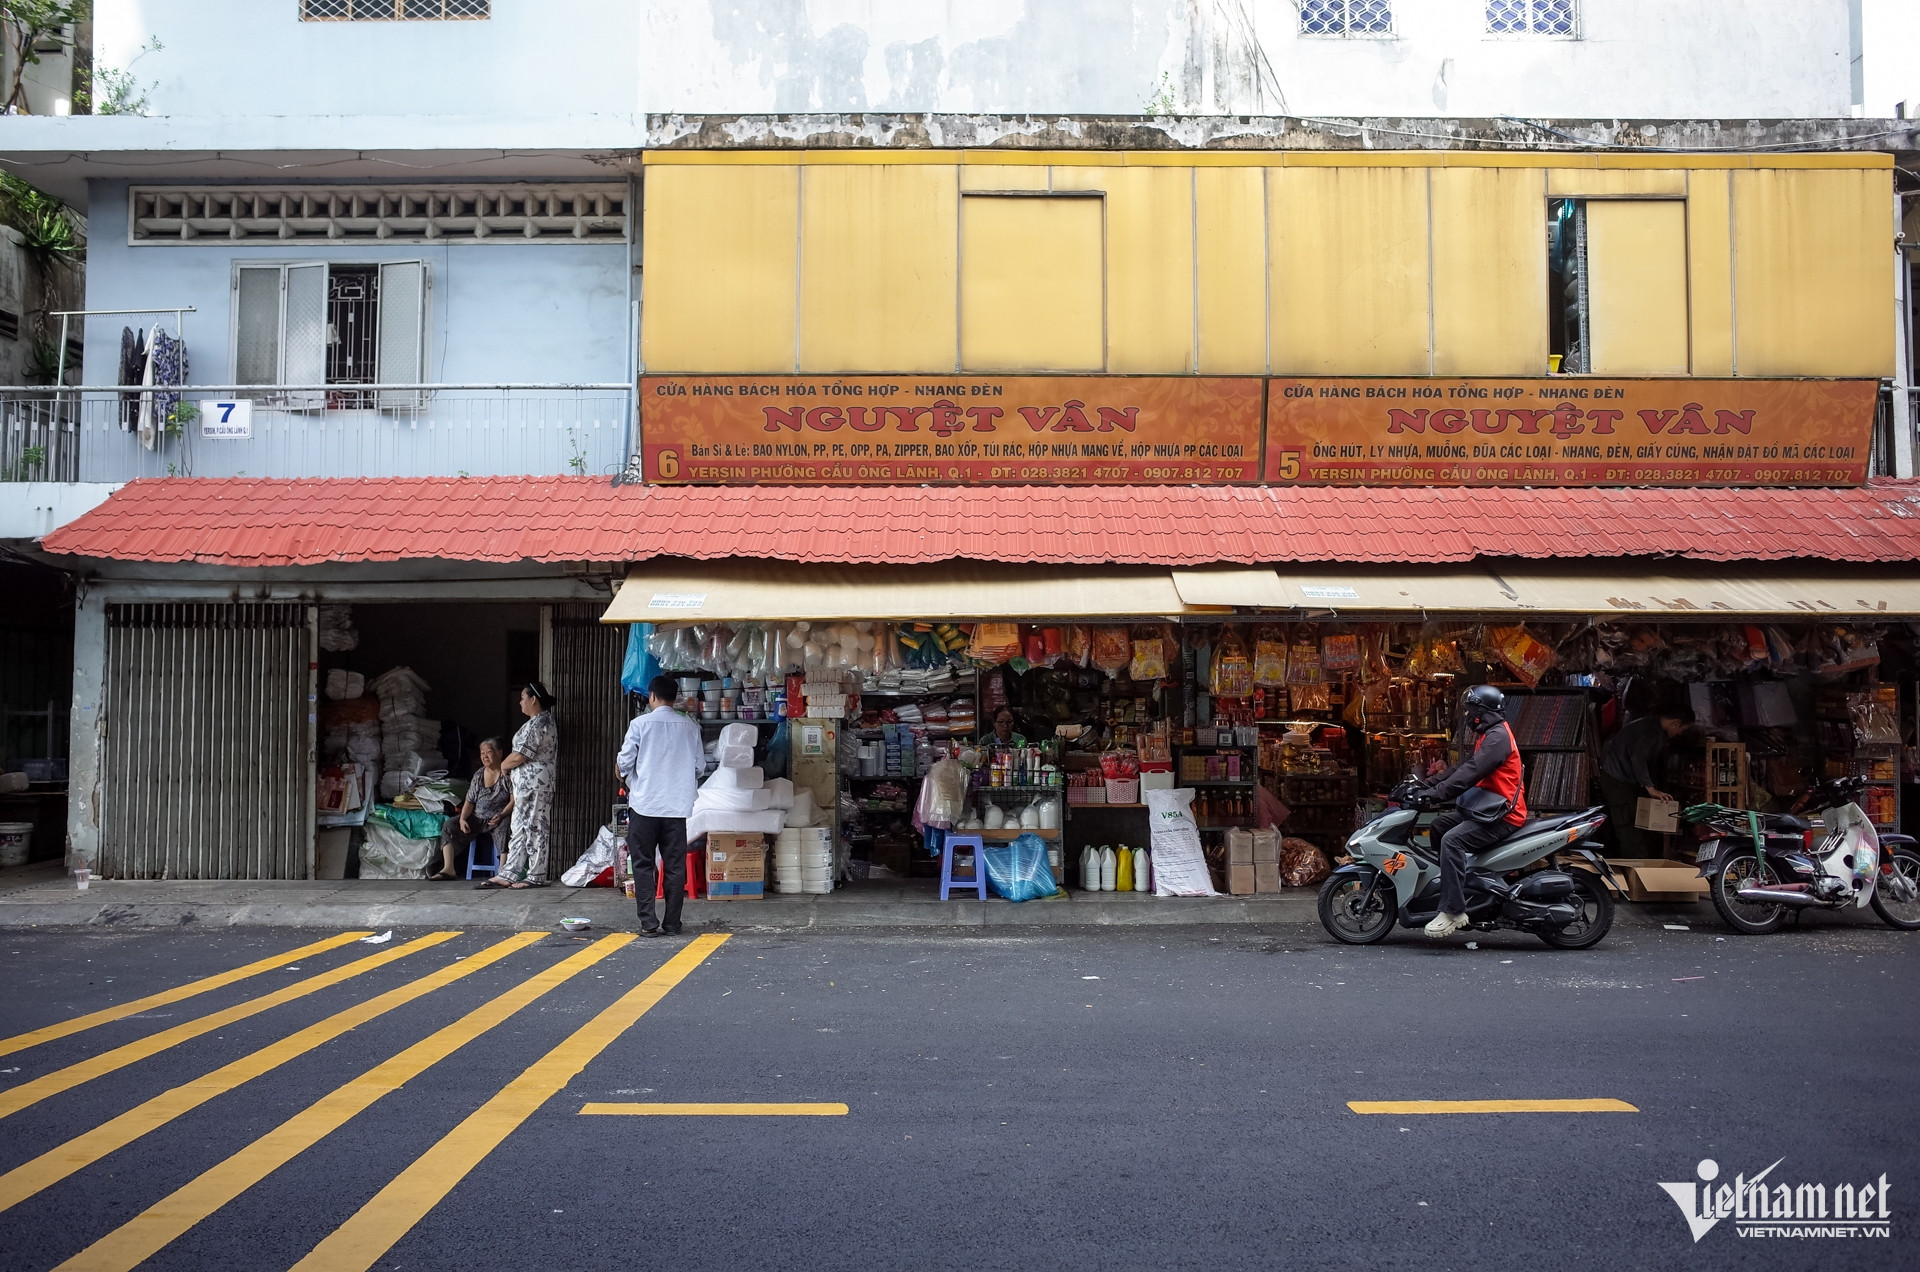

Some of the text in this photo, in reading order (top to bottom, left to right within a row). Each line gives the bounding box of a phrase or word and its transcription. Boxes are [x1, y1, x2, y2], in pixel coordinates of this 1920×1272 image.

[656, 380, 687, 396] CỬA
[692, 380, 734, 396] HÀNG
[739, 380, 780, 396] BÁCH
[785, 380, 817, 396] HÓA
[821, 379, 863, 396] TỔNG
[868, 384, 900, 397] HỢP
[914, 385, 966, 396] NHANG
[970, 381, 1003, 396] ĐÈN
[1283, 383, 1314, 398] CỬA
[1319, 382, 1361, 398] HÀNG
[1365, 382, 1406, 398] BÁCH
[1412, 382, 1443, 398] HÓA
[1448, 382, 1488, 398] TỔNG
[1493, 386, 1524, 400] HỢP
[1538, 388, 1588, 399] NHANG
[1593, 384, 1624, 399] ĐÈN
[216, 403, 236, 423] 7
[762, 399, 1141, 438] NGUYỆT VÂN
[1386, 402, 1757, 439] NGUYỆT VÂN
[692, 444, 710, 457] Bán
[725, 446, 732, 456] &
[753, 445, 772, 457] BAO
[775, 445, 810, 459] NYLON,
[813, 445, 830, 459] PP,
[832, 445, 848, 459] PE,
[851, 445, 873, 459] OPP,
[876, 445, 892, 459] PA,
[894, 445, 932, 459] ZIPPER,
[935, 445, 954, 457] BAO
[958, 440, 980, 459] XỐP,
[983, 441, 1000, 457] TÚI
[1002, 441, 1026, 459] RÁC,
[1028, 442, 1049, 460] HỘP
[1051, 444, 1078, 460] NHỰA
[1081, 445, 1109, 457] MANG
[1111, 439, 1128, 459] VỀ,
[1130, 442, 1151, 460] HỘP
[1153, 444, 1181, 460] NHỰA
[1184, 445, 1197, 457] PP
[1199, 440, 1220, 457] CÁC
[1221, 445, 1243, 460] LOẠI
[1313, 440, 1336, 458] ỐNG
[1340, 441, 1366, 460] HÚT,
[1370, 446, 1384, 458] LY
[1388, 443, 1422, 460] NHỰA,
[1426, 439, 1468, 460] MUỖNG,
[1472, 442, 1497, 458] ĐŨA
[1500, 441, 1522, 458] CÁC
[1526, 446, 1552, 461] LOẠI
[1562, 446, 1602, 460] NHANG,
[1606, 442, 1632, 460] ĐÈN,
[1636, 440, 1662, 458] GIẤY
[1666, 442, 1699, 460] CÚNG,
[1703, 442, 1734, 461] NHẬN
[1737, 442, 1759, 461] ĐẶT
[1762, 440, 1779, 458] ĐỒ
[1782, 443, 1800, 458] MÃ
[1803, 442, 1826, 458] CÁC
[1829, 447, 1854, 462] LOẠI
[657, 449, 680, 479] 6
[688, 466, 746, 479] YERSIN
[751, 464, 816, 479] PHƯỜNG
[823, 462, 853, 479] CẦU
[857, 463, 892, 479] ÔNG
[896, 463, 943, 480] LÃNH,
[947, 466, 972, 479] Q.1
[990, 466, 1016, 479] ĐT:
[1020, 466, 1088, 479] 028.3821
[1093, 466, 1130, 479] 4707
[1143, 466, 1212, 479] 0907.812
[1216, 466, 1243, 479] 707
[1278, 451, 1300, 480] 5
[1308, 468, 1366, 480] YERSIN
[1370, 466, 1434, 480] PHƯỜNG
[1442, 464, 1471, 480] CẦU
[1476, 465, 1509, 480] ÔNG
[1514, 465, 1559, 482] LÃNH,
[1564, 469, 1587, 480] Q.1
[1606, 469, 1631, 480] ĐT:
[1634, 469, 1700, 480] 028.3821
[1705, 469, 1740, 480] 4707
[1754, 470, 1822, 480] 0907.812
[1826, 470, 1852, 481] 707
